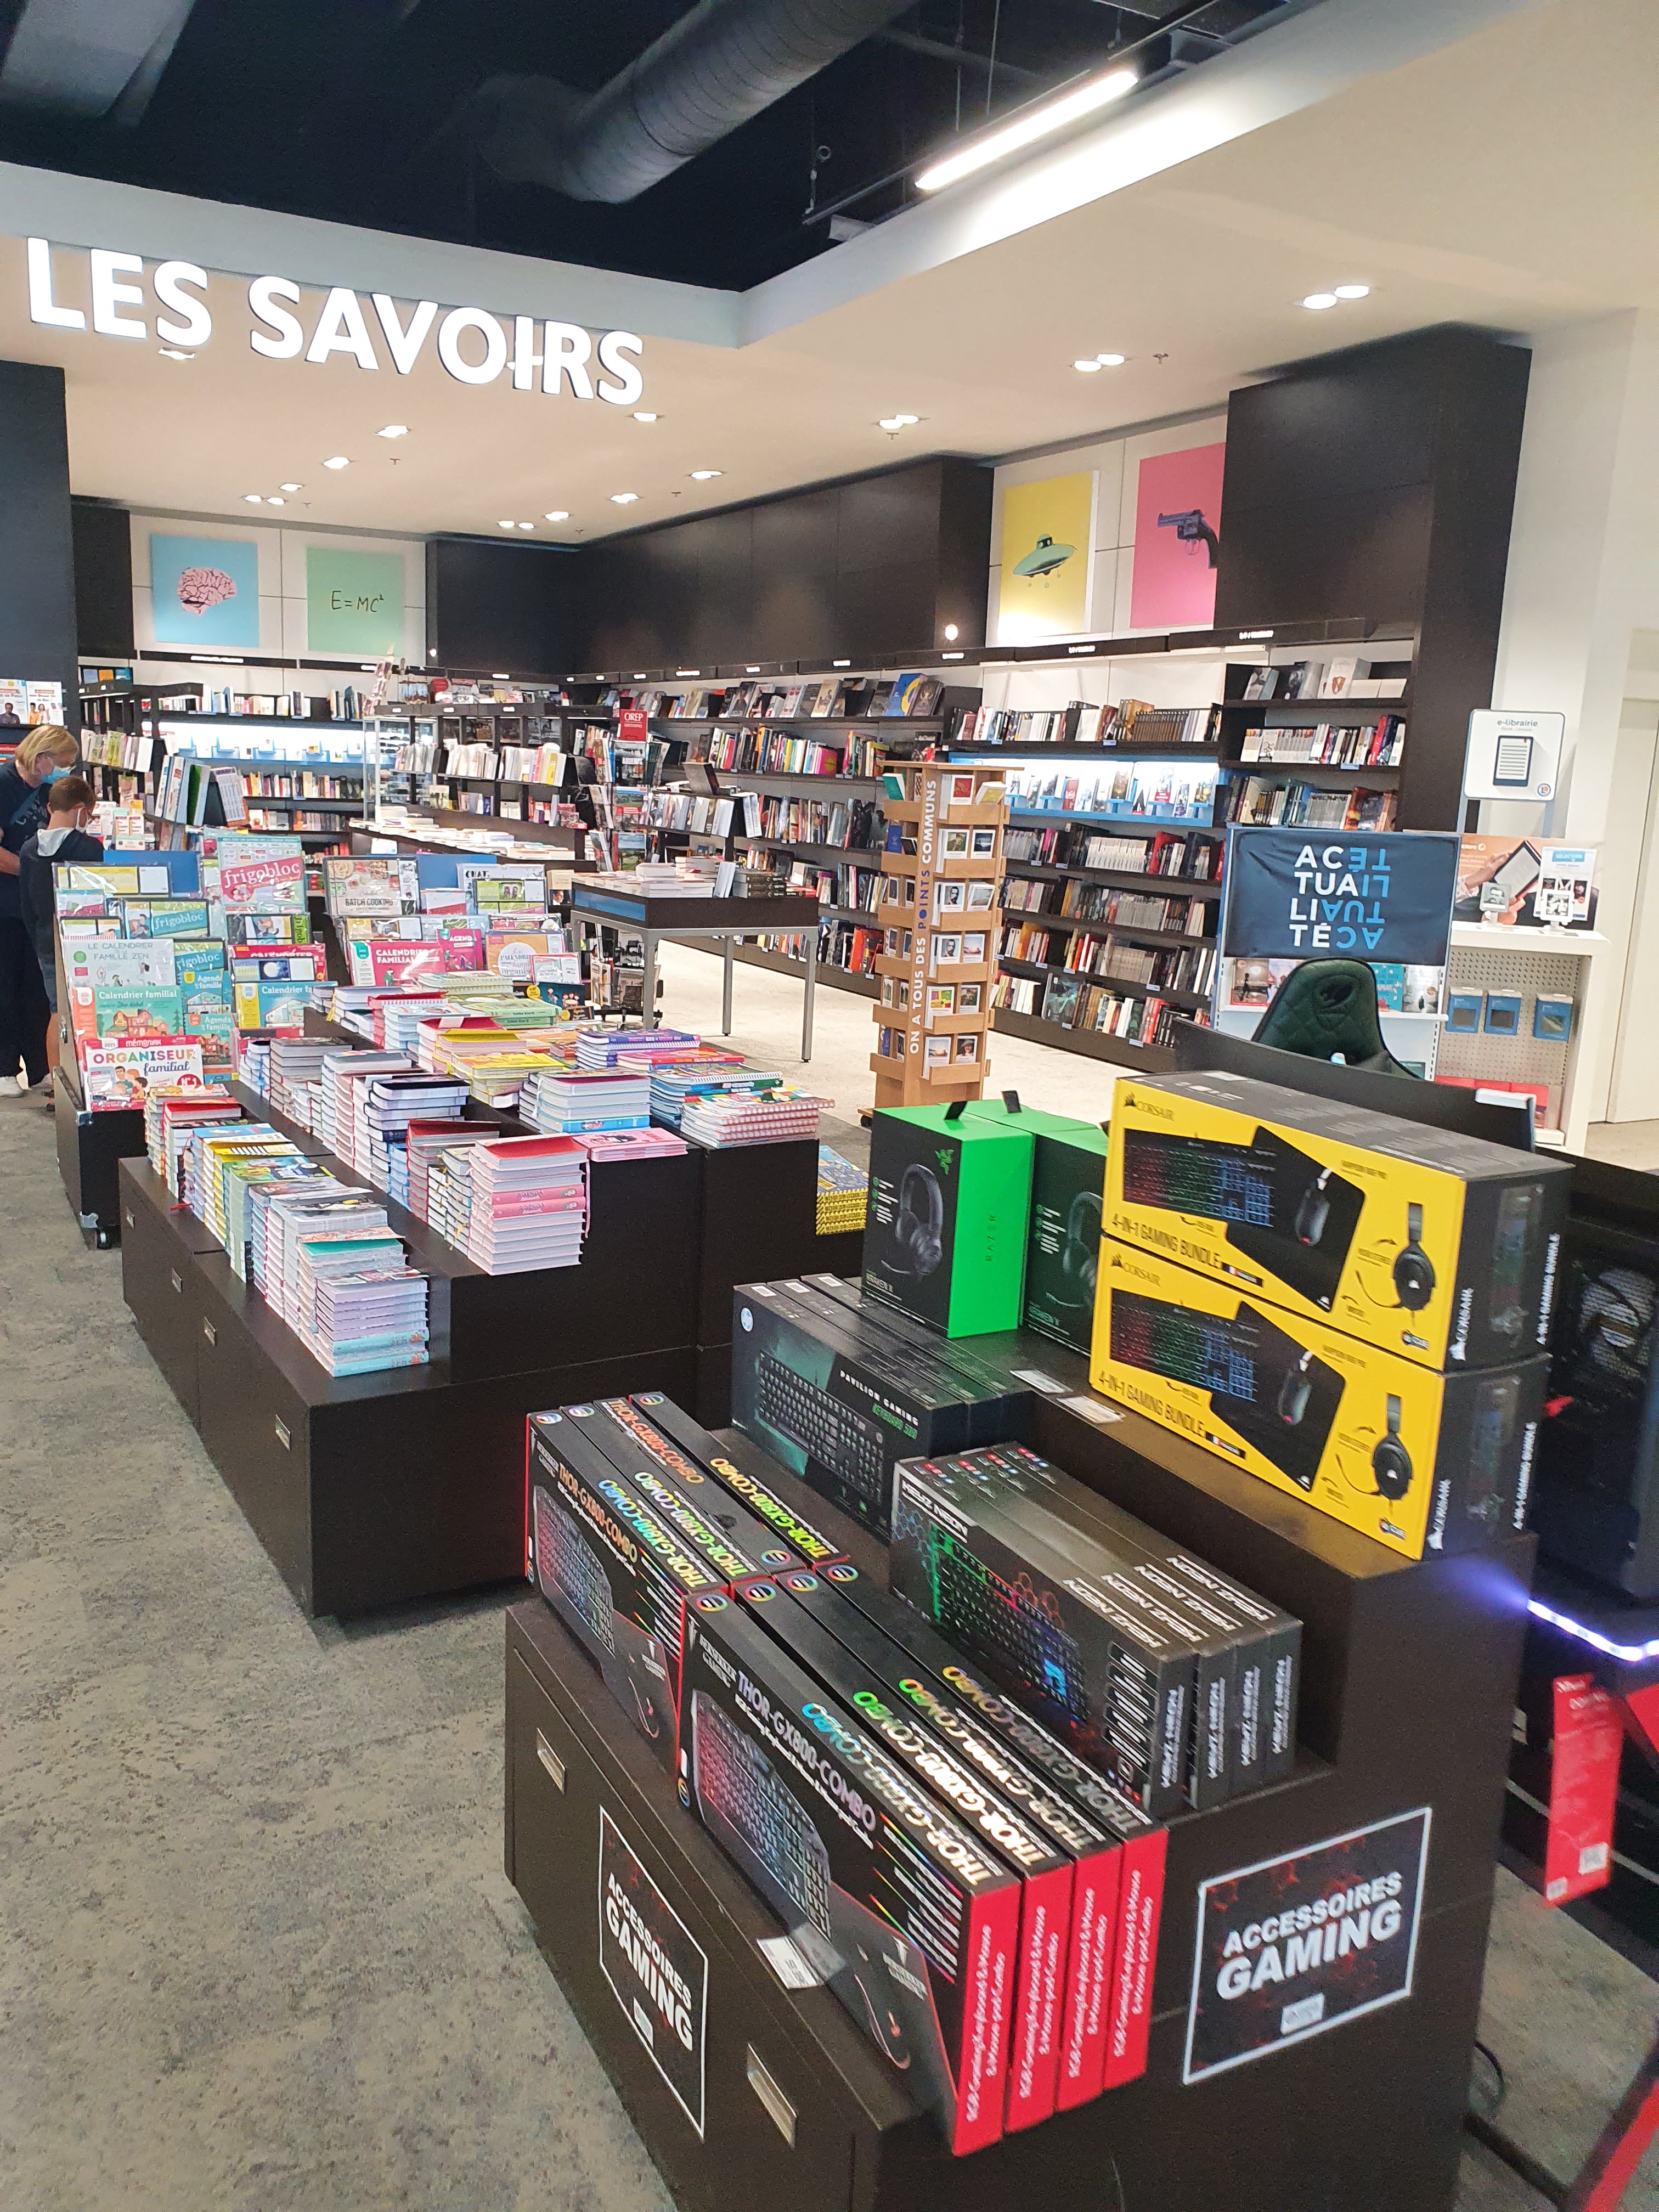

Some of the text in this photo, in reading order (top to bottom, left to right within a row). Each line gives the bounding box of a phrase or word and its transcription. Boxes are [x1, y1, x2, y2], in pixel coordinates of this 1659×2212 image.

[28, 238, 644, 405] LES SAVOIRS
[624, 712, 644, 721] OREP
[1497, 719, 1538, 727] e-librairie
[223, 861, 301, 888] frigobloc
[345, 898, 394, 906] BATCH COOKING
[154, 913, 204, 930] frigobloc
[909, 780, 937, 1055] ON A TOUS DES POINTS COMMUNS
[176, 953, 219, 970] rigobloc
[99, 990, 177, 1000] Calendrier familial
[93, 1049, 197, 1064] ORGANISEUR
[144, 1061, 190, 1076] familial
[1135, 1100, 1175, 1121] CORSAIR
[1180, 1238, 1223, 1271] BUNDLE
[839, 1370, 881, 1404] PAVILION
[883, 1397, 919, 1426] GAMING
[1165, 1400, 1206, 1438] BUNDLE
[737, 1671, 877, 1832] THOR-GX800-COMBO
[1222, 1871, 1402, 1958] ACCESSOIRES
[608, 1871, 692, 2011] ACCESSOIRES
[1216, 1899, 1402, 2000] GAMING
[606, 1895, 693, 2051] GAMING
